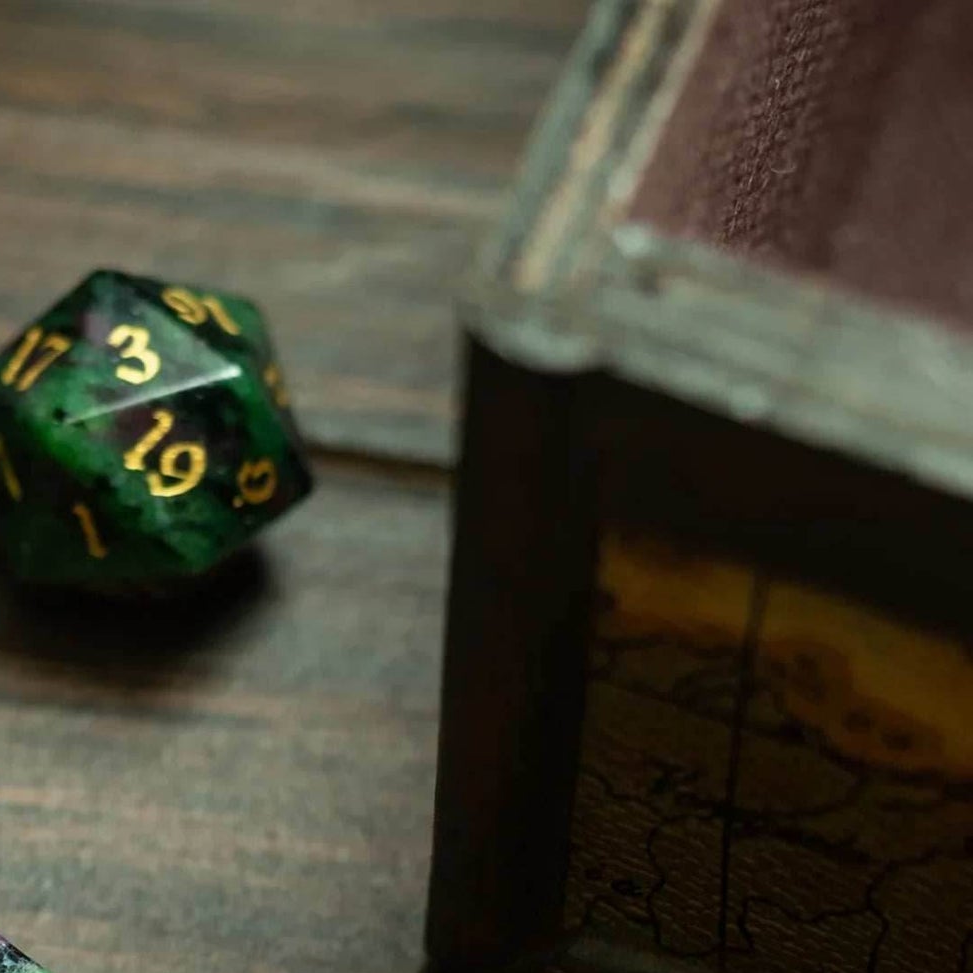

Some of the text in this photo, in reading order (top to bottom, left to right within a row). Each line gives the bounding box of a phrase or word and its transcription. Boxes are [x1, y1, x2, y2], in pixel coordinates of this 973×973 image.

[0, 326, 71, 391] 17
[107, 324, 161, 384] 3
[123, 409, 207, 497] 19
[73, 503, 107, 559] 1
